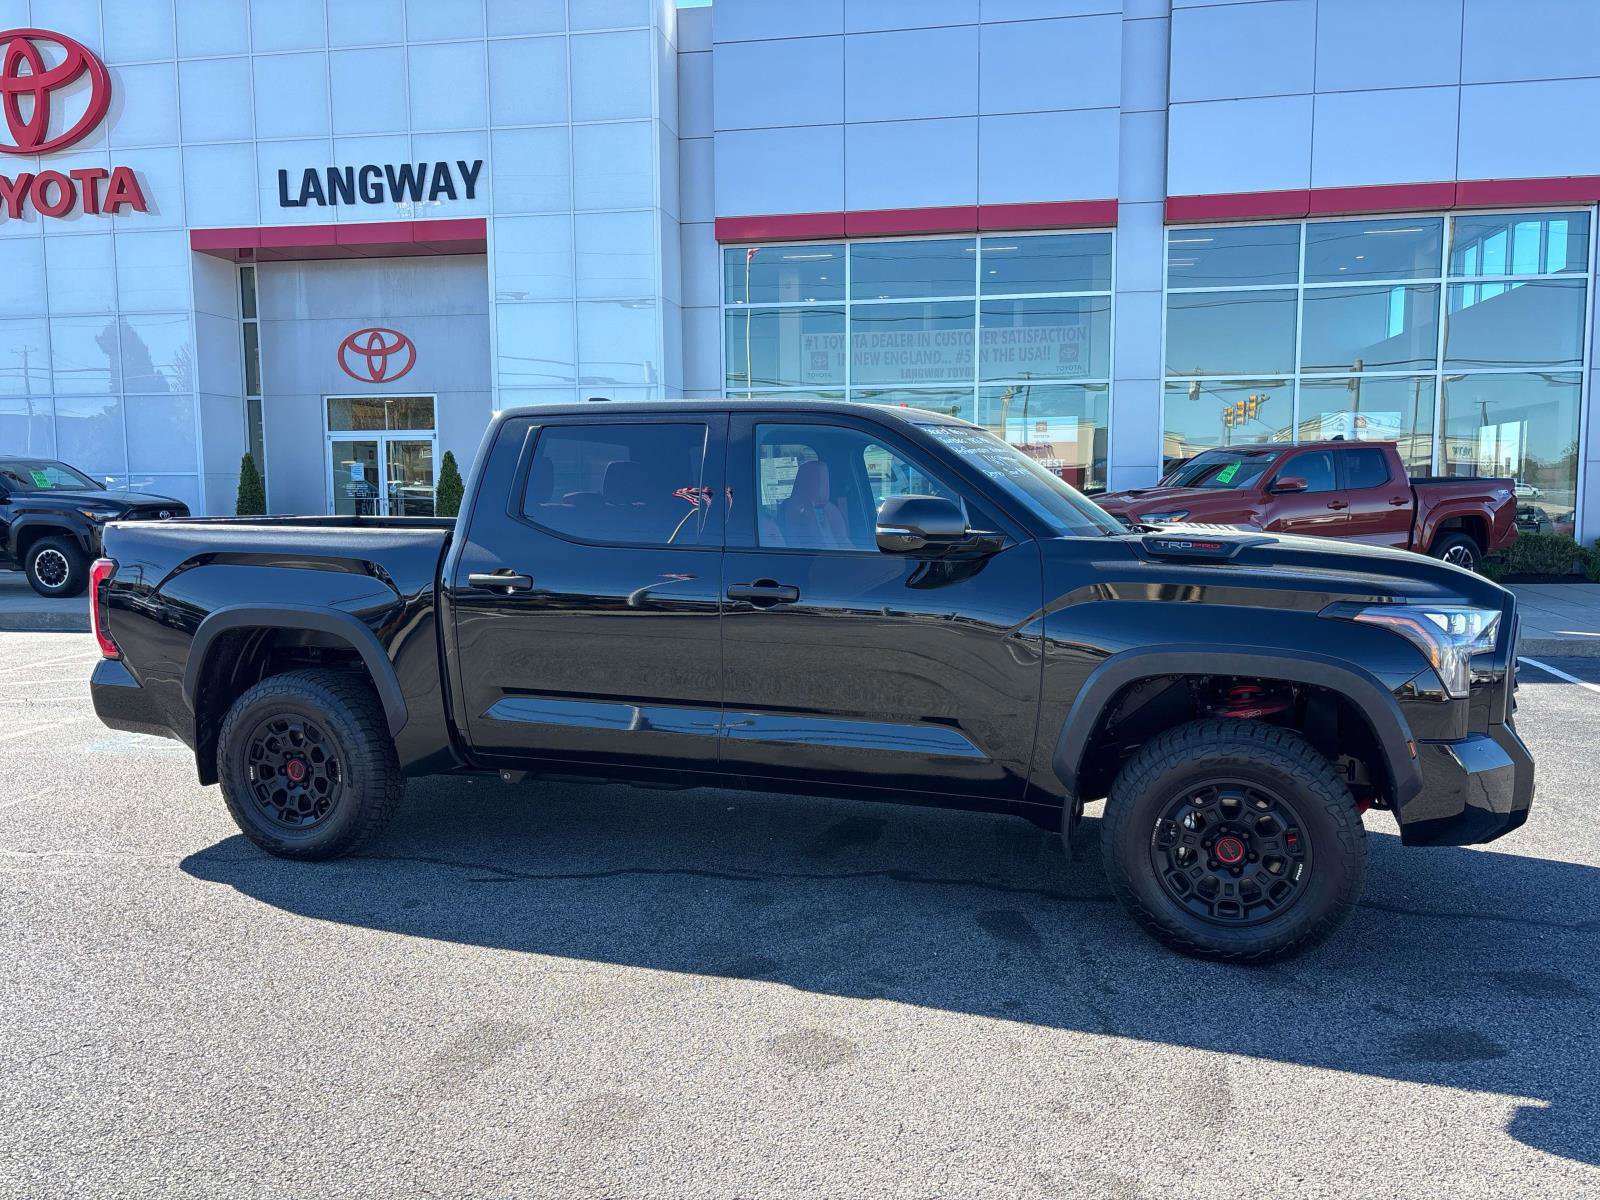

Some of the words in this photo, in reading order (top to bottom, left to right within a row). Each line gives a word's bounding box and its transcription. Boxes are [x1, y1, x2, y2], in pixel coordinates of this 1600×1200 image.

[0, 167, 148, 219] YOTA
[278, 160, 482, 207] LANGWAY
[804, 335, 818, 350] #1
[822, 333, 869, 350] TOYTA
[871, 332, 915, 347] DEALER
[918, 332, 931, 347] IN
[1000, 326, 1087, 345] SATISFACTION
[853, 351, 880, 366] NEW
[993, 347, 1015, 362] THE
[901, 366, 945, 379] LANGWAY
[948, 367, 976, 378] TOYOT
[1055, 364, 1082, 372] TOYOTA
